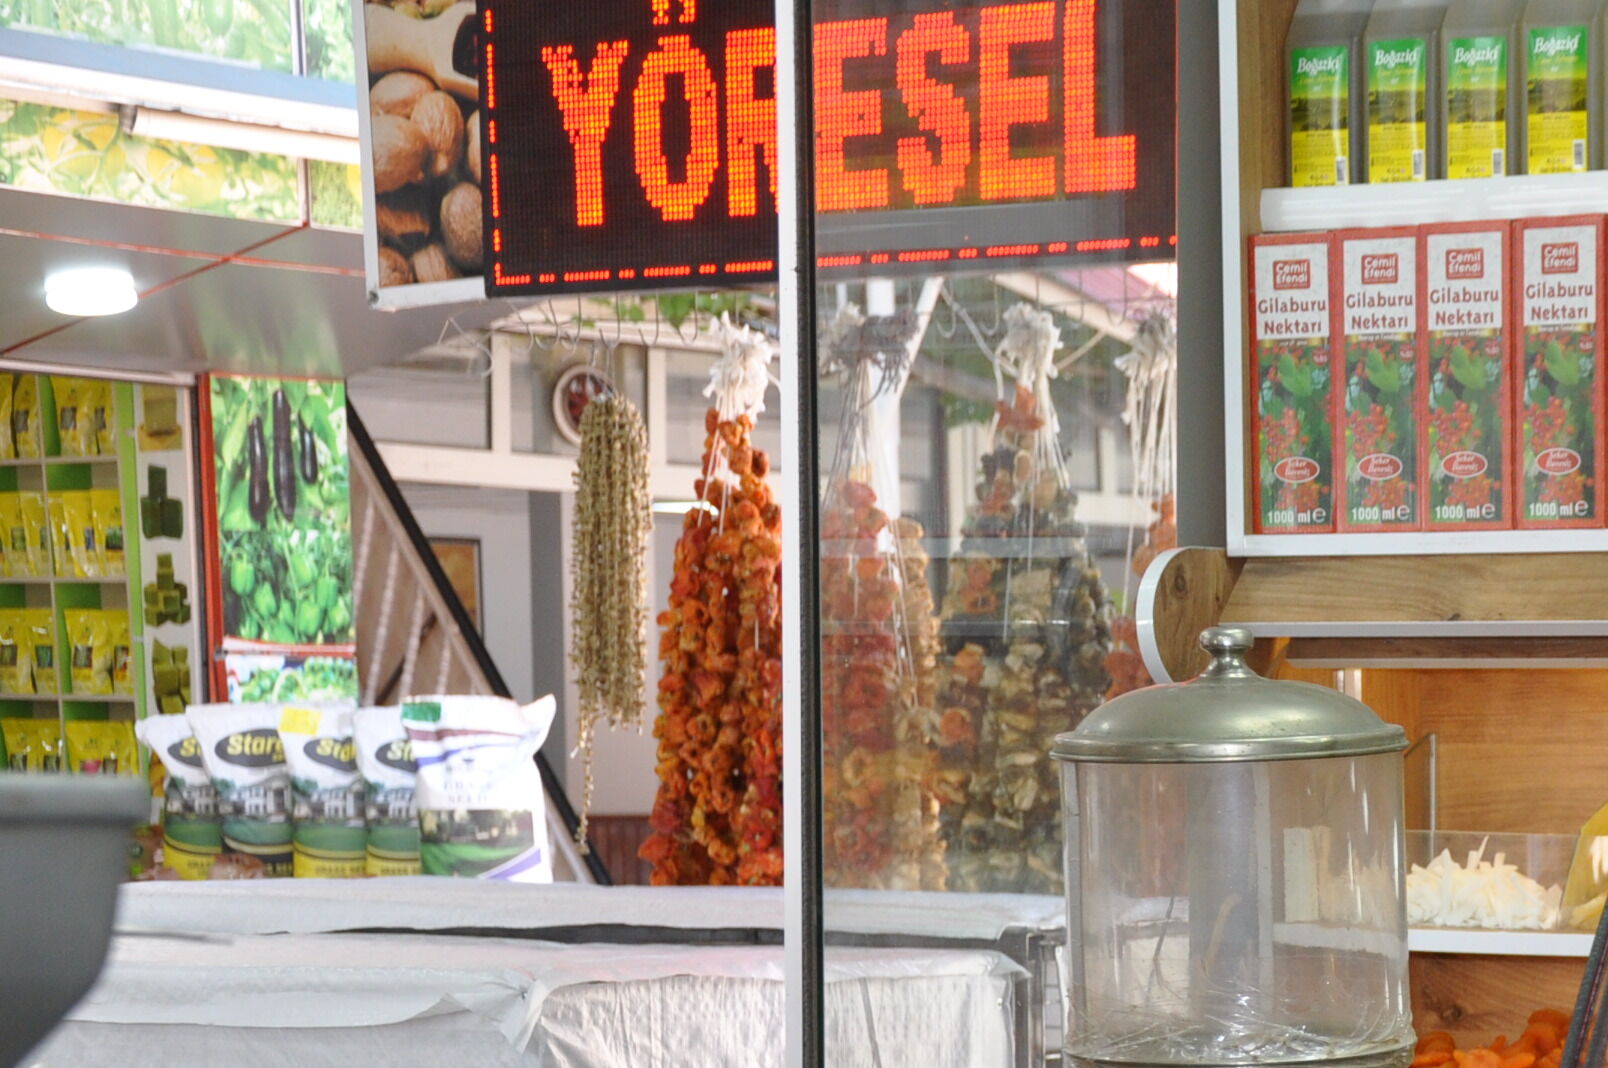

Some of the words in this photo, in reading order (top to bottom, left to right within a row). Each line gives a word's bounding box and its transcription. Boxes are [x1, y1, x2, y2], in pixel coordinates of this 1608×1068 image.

[1449, 251, 1481, 262] Cemil
[1544, 245, 1576, 256] Cemil
[1276, 262, 1308, 273] Cemil
[1364, 256, 1396, 267] Cemil
[1449, 262, 1481, 273] Efendi
[1544, 256, 1576, 268] Efendi
[1275, 272, 1308, 284] Efendi
[1364, 267, 1396, 279] Efendi
[1430, 287, 1499, 304] Gilaburu
[1525, 281, 1593, 299] Gilaburu
[1258, 297, 1327, 314] Gilaburu
[1345, 291, 1413, 309] Gilaburu
[1435, 308, 1494, 325] Nektarı
[1531, 304, 1588, 321] Nektarı
[1264, 318, 1321, 335] Nektarı
[1351, 313, 1408, 329] Nektarı
[1268, 510, 1294, 524] 1000
[1298, 509, 1310, 522] ml
[1352, 507, 1379, 521] 1000
[1382, 506, 1395, 520] ml
[1435, 505, 1463, 519] 1000
[1466, 505, 1480, 518] ml
[1529, 502, 1557, 517] 1000
[1559, 502, 1573, 516] ml
